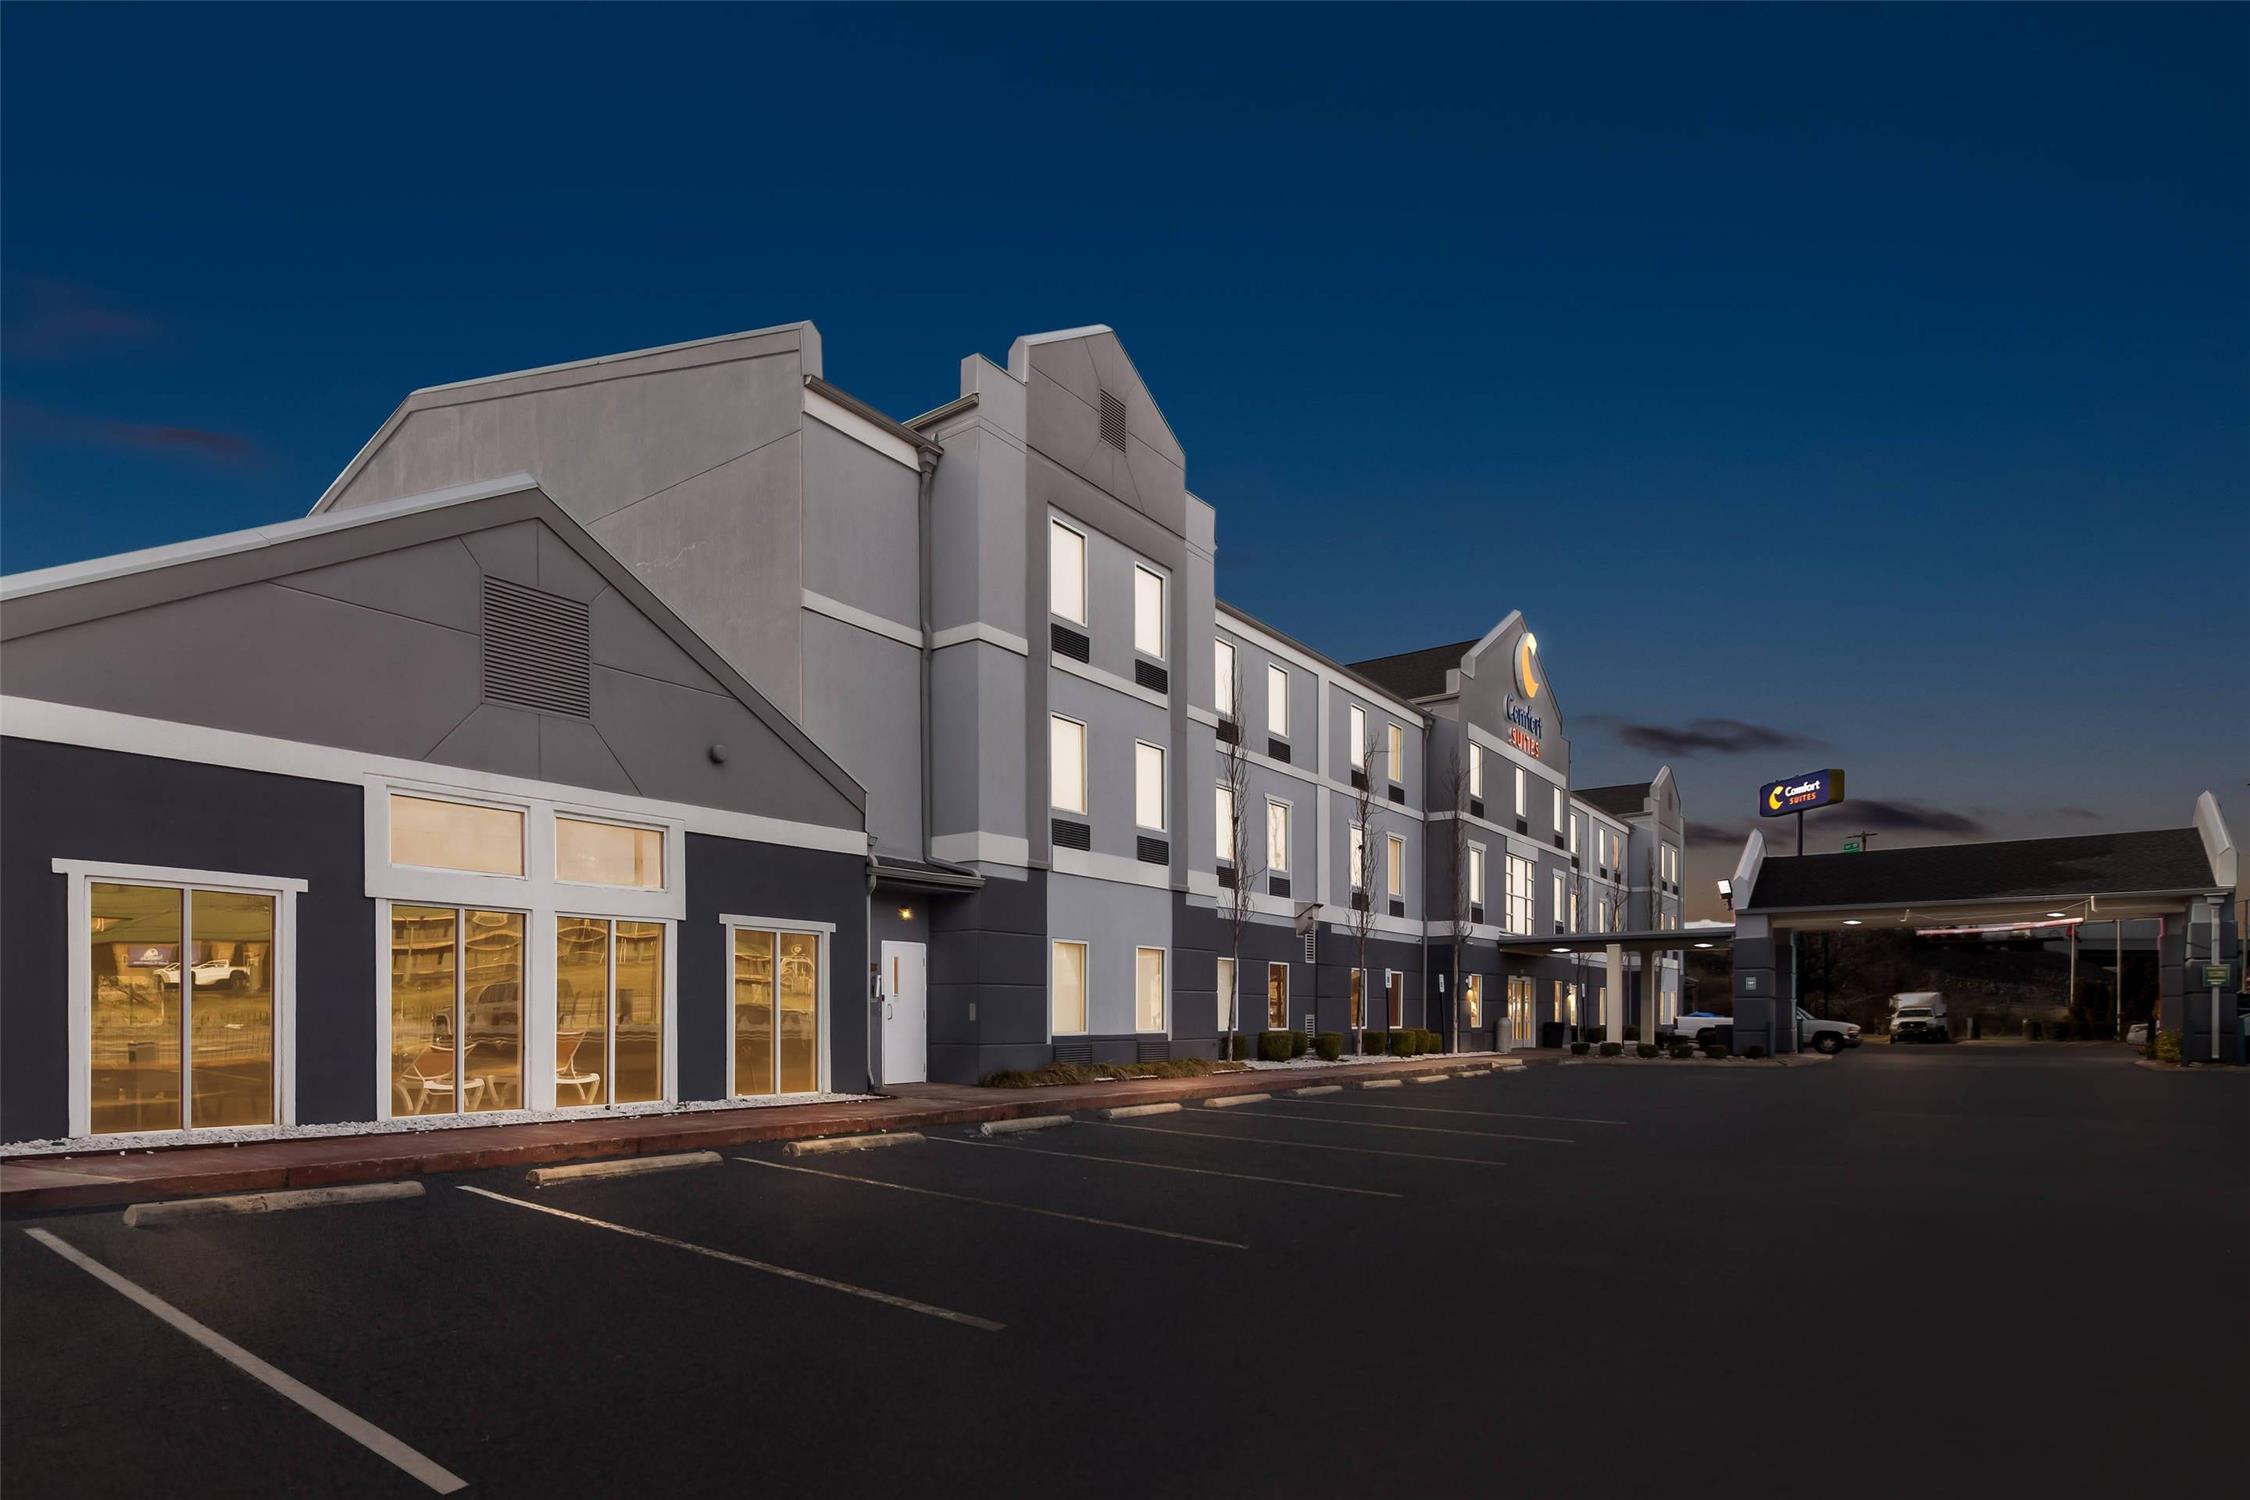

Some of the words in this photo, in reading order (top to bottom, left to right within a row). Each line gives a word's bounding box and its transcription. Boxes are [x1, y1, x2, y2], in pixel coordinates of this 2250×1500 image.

[1505, 693, 1542, 740] Comfort
[1510, 727, 1540, 758] SUITES
[1785, 780, 1820, 797] Comfort
[1789, 792, 1817, 805] SUITES
